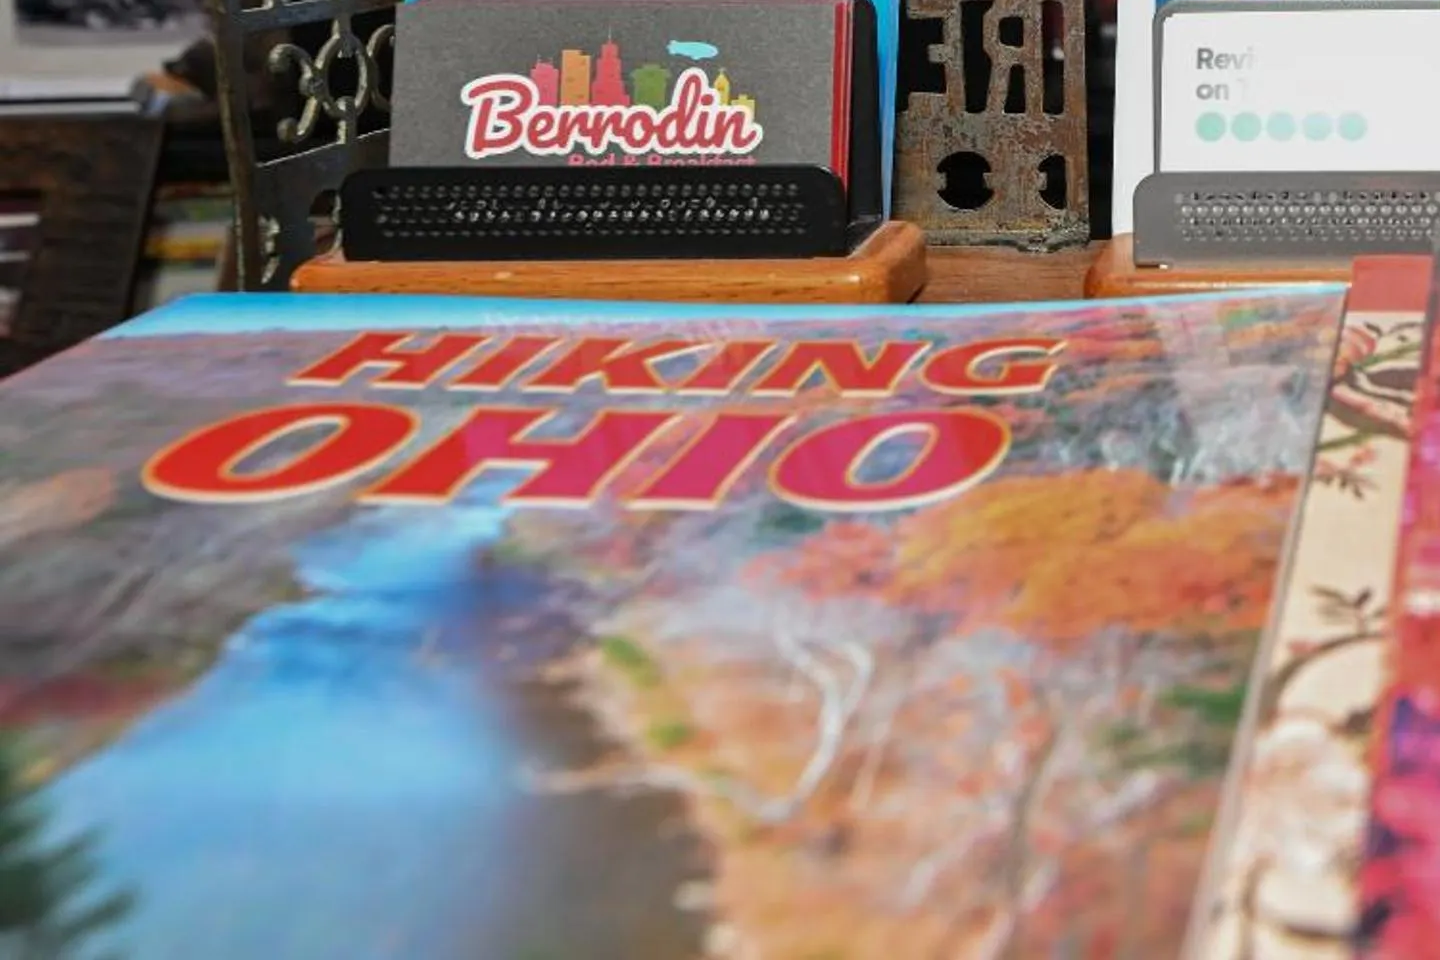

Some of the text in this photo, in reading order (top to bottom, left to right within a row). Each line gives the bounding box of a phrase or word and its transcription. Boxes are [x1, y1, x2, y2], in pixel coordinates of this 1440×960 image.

[461, 68, 762, 159] Berrodin
[1195, 83, 1230, 101] on
[285, 329, 1070, 400] HIKING
[140, 400, 1012, 512] OHIO
